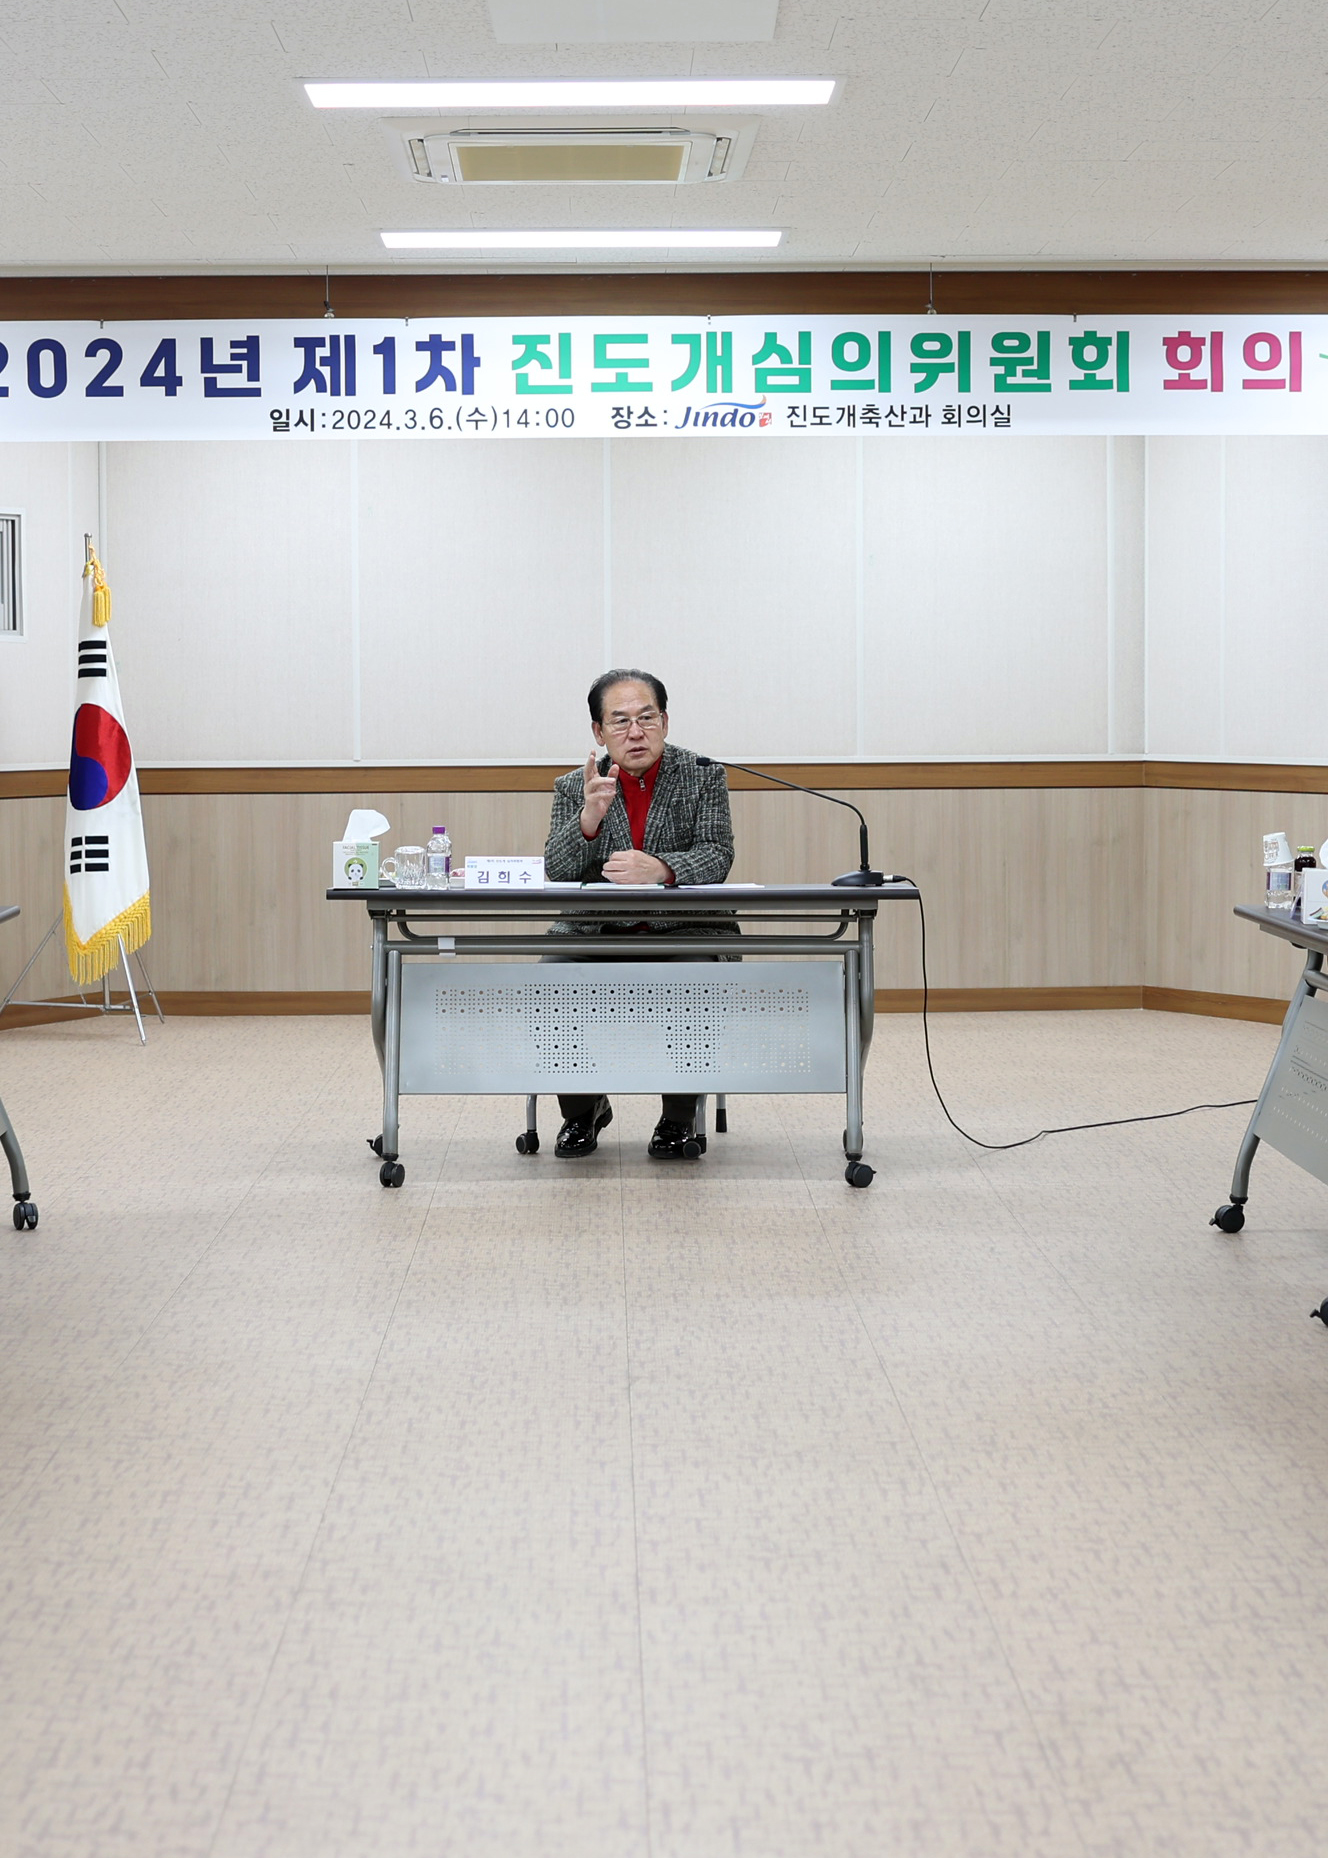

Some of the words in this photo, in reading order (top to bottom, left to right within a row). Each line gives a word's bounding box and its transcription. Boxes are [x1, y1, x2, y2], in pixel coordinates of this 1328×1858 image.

[293, 333, 481, 397] 제1차
[511, 330, 1130, 395] 진도개심의위원회
[1162, 330, 1302, 393] 회의
[674, 404, 757, 430] Jindo
[786, 403, 932, 429] 진도개축산과
[940, 403, 1011, 428] 회의실
